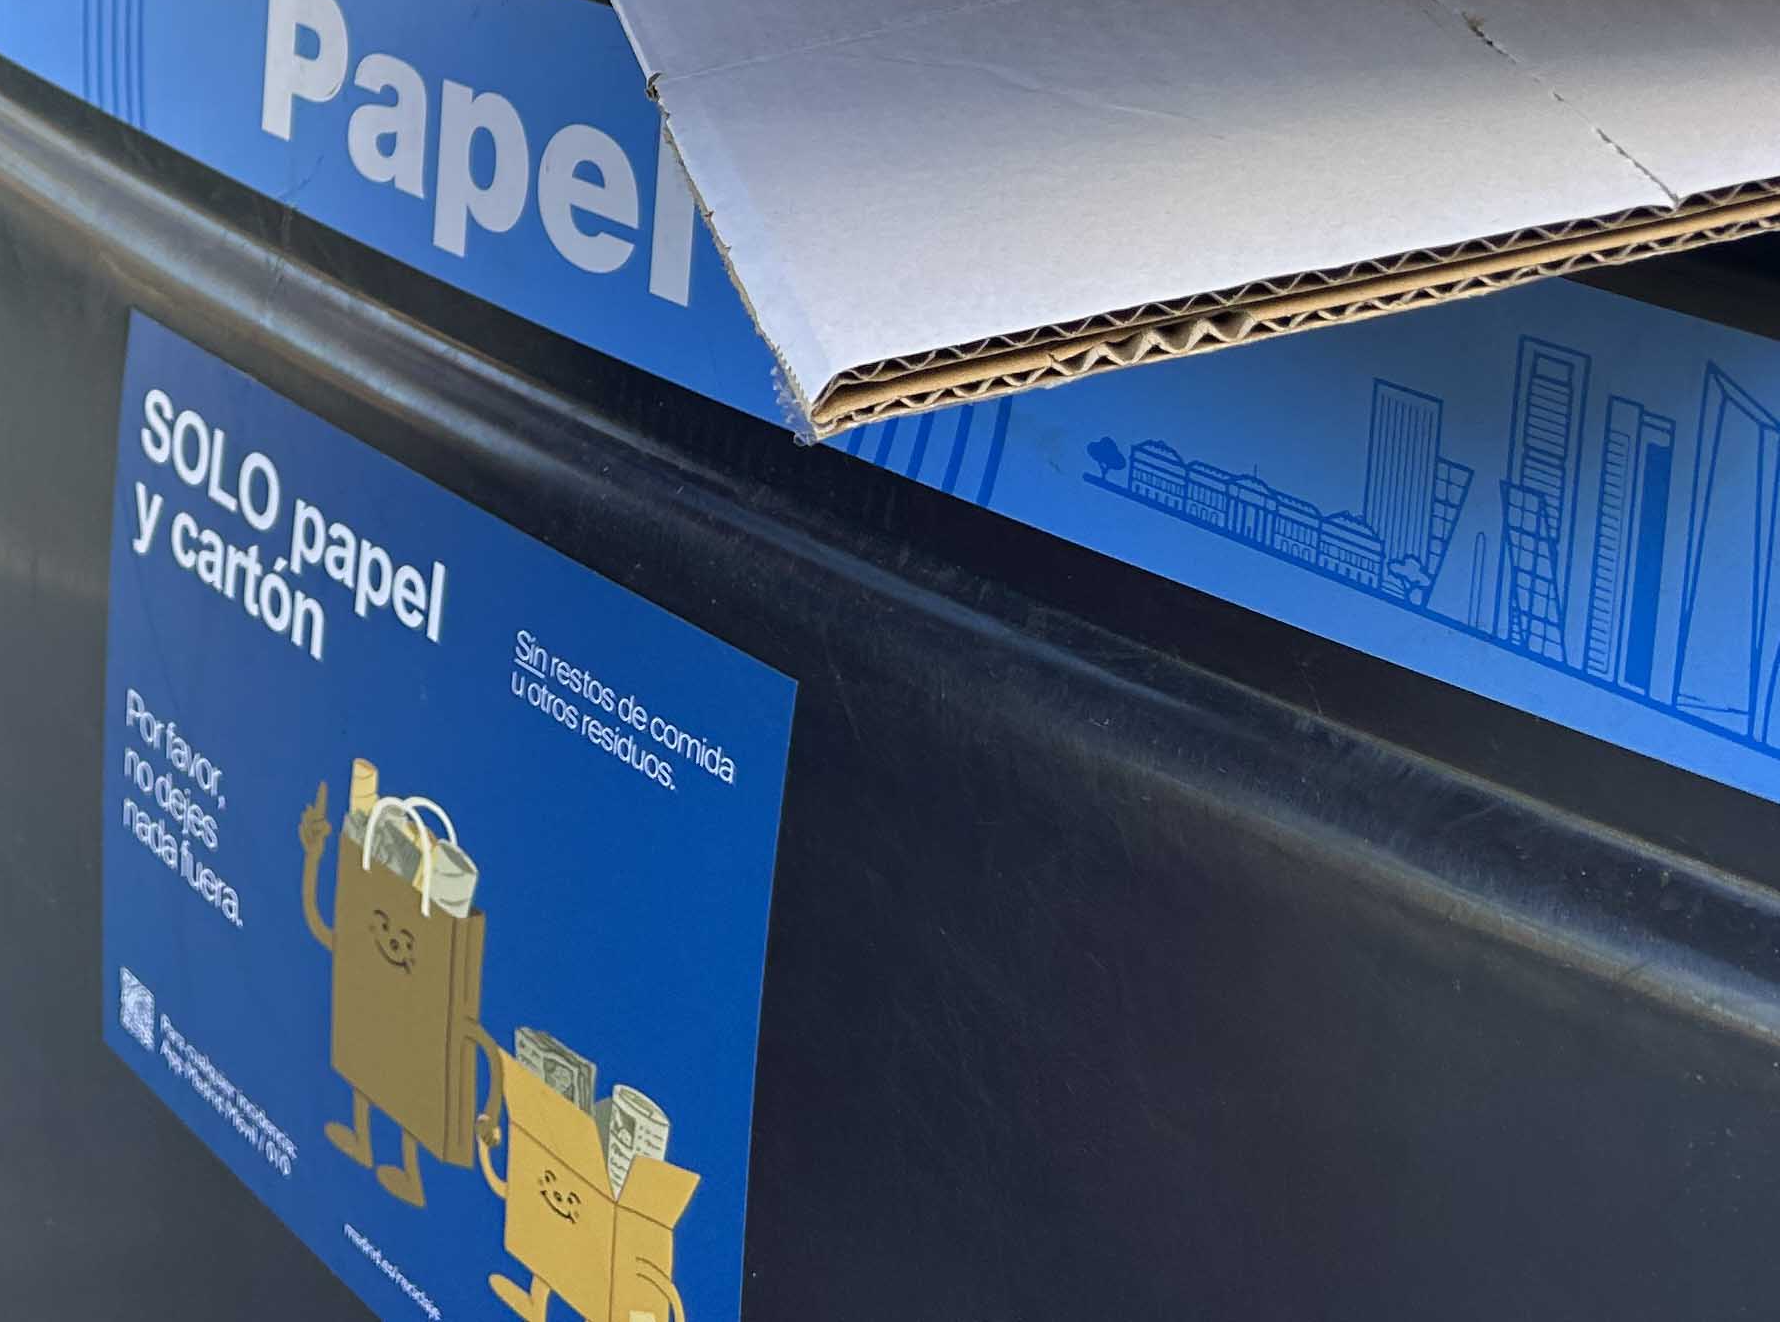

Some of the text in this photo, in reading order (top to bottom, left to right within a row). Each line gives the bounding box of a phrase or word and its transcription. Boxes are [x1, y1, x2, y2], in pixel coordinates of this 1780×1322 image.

[131, 480, 325, 663] y cartón
[138, 388, 447, 645] SOLO papel
[125, 687, 165, 750] Por
[510, 670, 677, 792] u otros residuos.
[514, 629, 737, 786] Sin restos de comida
[122, 796, 244, 929] nada fuera.
[124, 746, 219, 850] no dejes
